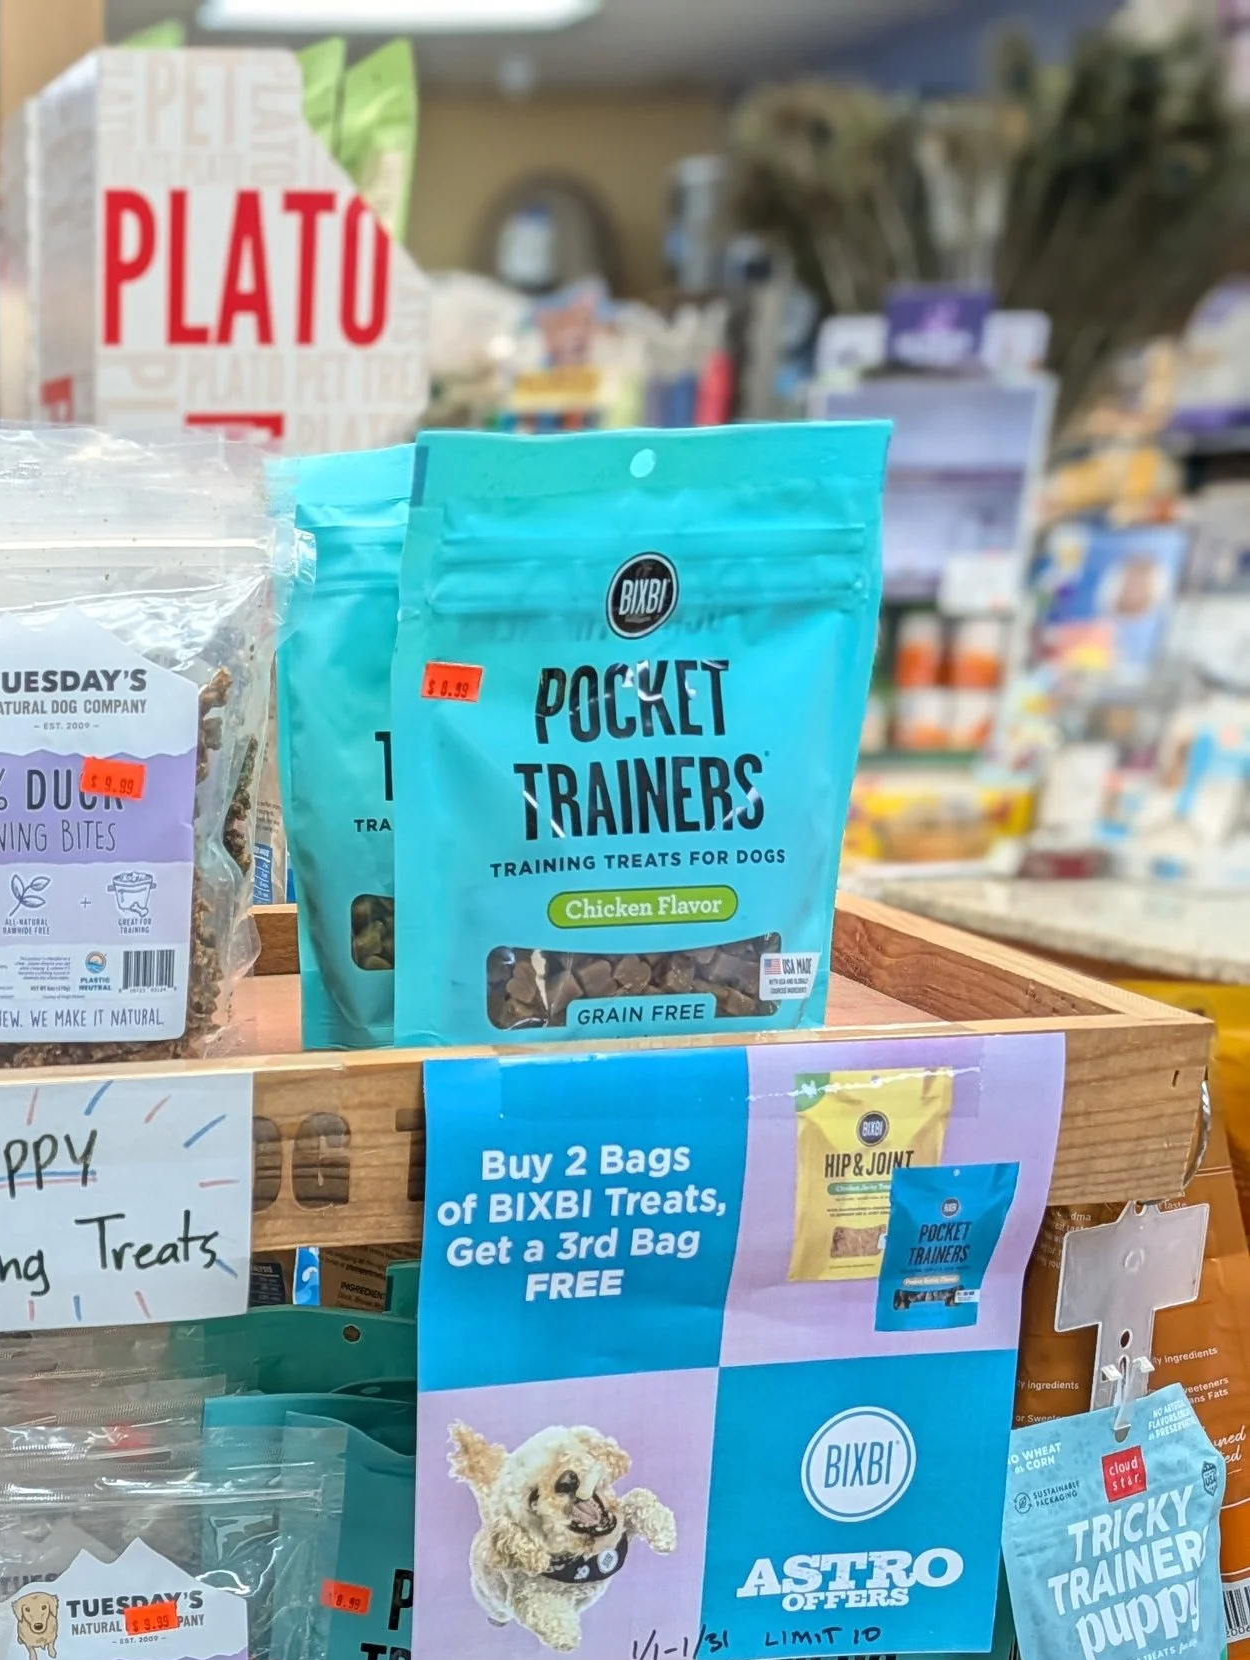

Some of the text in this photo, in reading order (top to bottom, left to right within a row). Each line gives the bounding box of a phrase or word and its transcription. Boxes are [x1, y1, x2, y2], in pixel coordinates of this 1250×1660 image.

[103, 189, 391, 348] PLATO
[618, 578, 672, 616] BIXBI
[534, 658, 730, 745] POCKET
[514, 752, 764, 841] TRAINERS
[490, 848, 786, 879] TRAINING TREATS FOR DOGS
[565, 895, 723, 920] Chicken Flavor
[782, 956, 813, 976] USA MADE
[576, 1002, 706, 1026] GRAIN FREE
[481, 1144, 691, 1182] Buy 2 Bags
[437, 1185, 726, 1227] of BIXBI Treats,
[75, 1210, 221, 1273] Treats
[447, 1227, 700, 1267] Get a 3rd Bag
[918, 1222, 973, 1243] POCKET
[908, 1245, 970, 1265] TRAINERS
[524, 1269, 623, 1301] FREE
[824, 1442, 893, 1488] BIXBI
[1068, 1485, 1195, 1563] TRICKY
[736, 1548, 964, 1598] ASTRO
[782, 1586, 909, 1612] OFFERS
[764, 1628, 842, 1647] LIMIT
